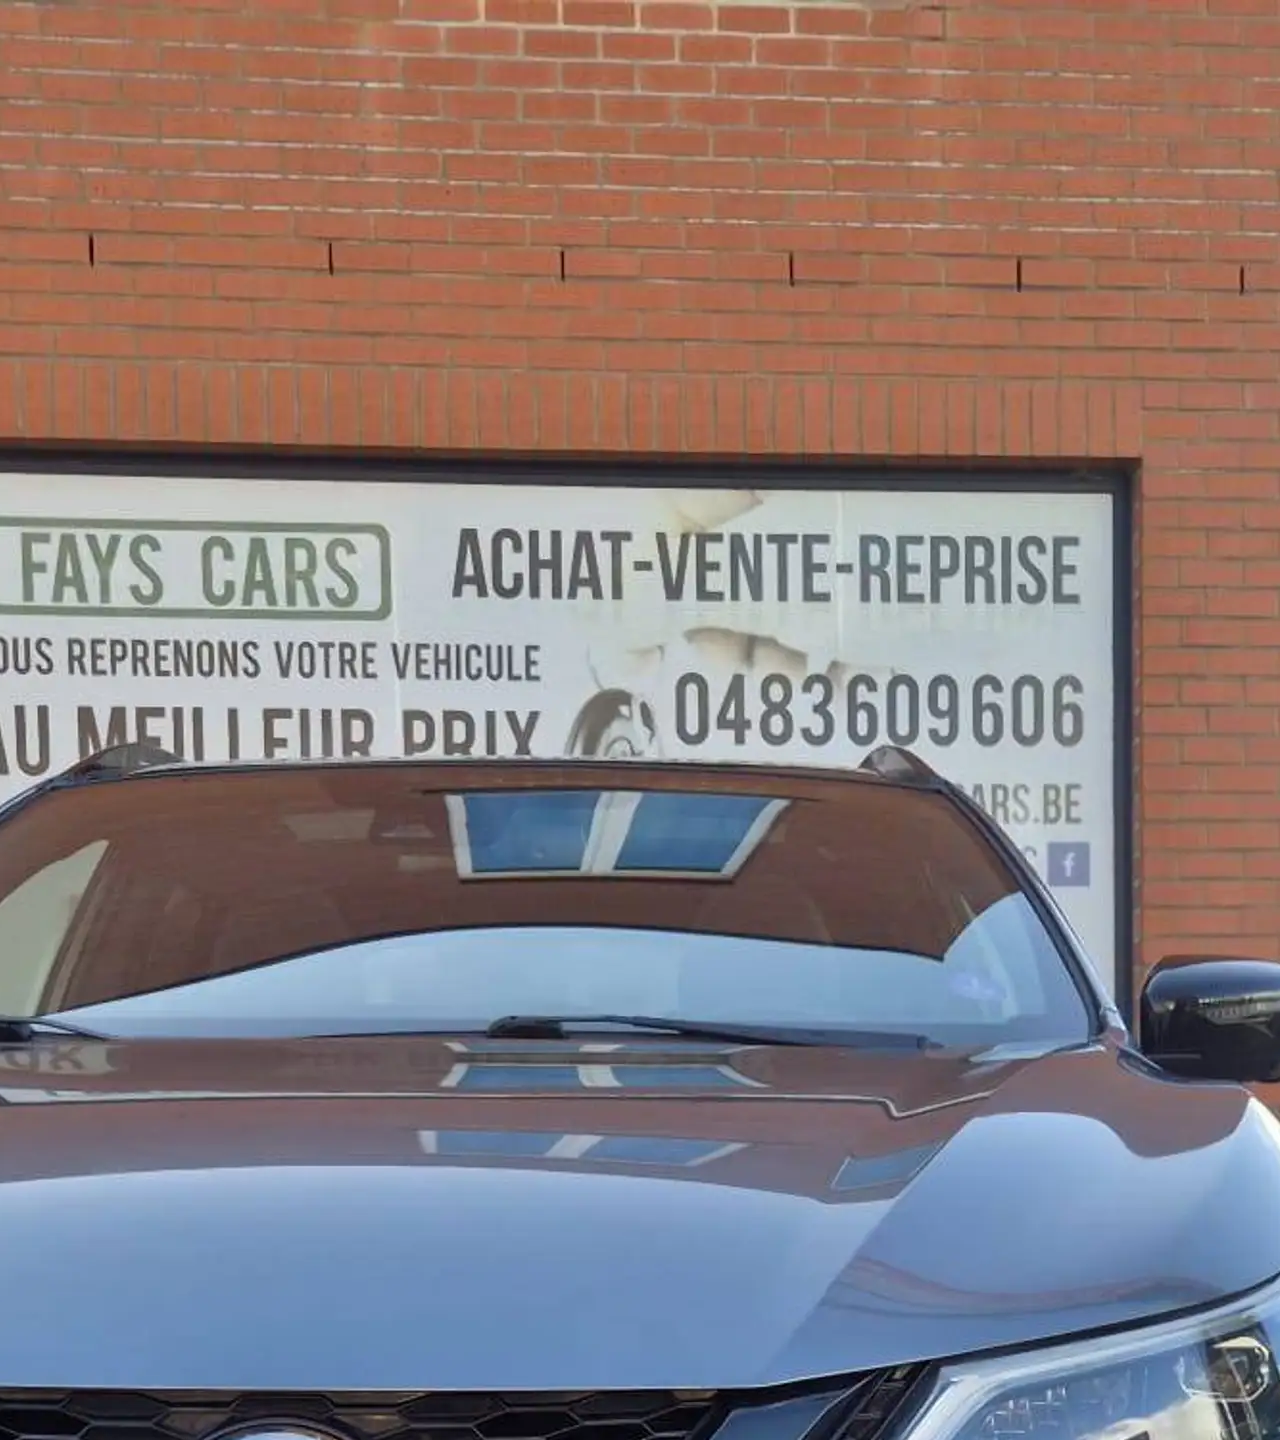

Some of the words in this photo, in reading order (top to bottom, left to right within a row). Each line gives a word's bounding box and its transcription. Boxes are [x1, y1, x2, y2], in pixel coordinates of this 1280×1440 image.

[21, 531, 163, 606] FAYS
[201, 535, 359, 608] CARS
[452, 527, 1080, 604] ACHAT-VENTE-REPRISE
[67, 638, 261, 678] REPRENONS
[274, 641, 377, 679] VOTRE
[392, 643, 541, 682] VEHICULE
[402, 710, 540, 755] PRIX
[674, 671, 1084, 748] 0483609606
